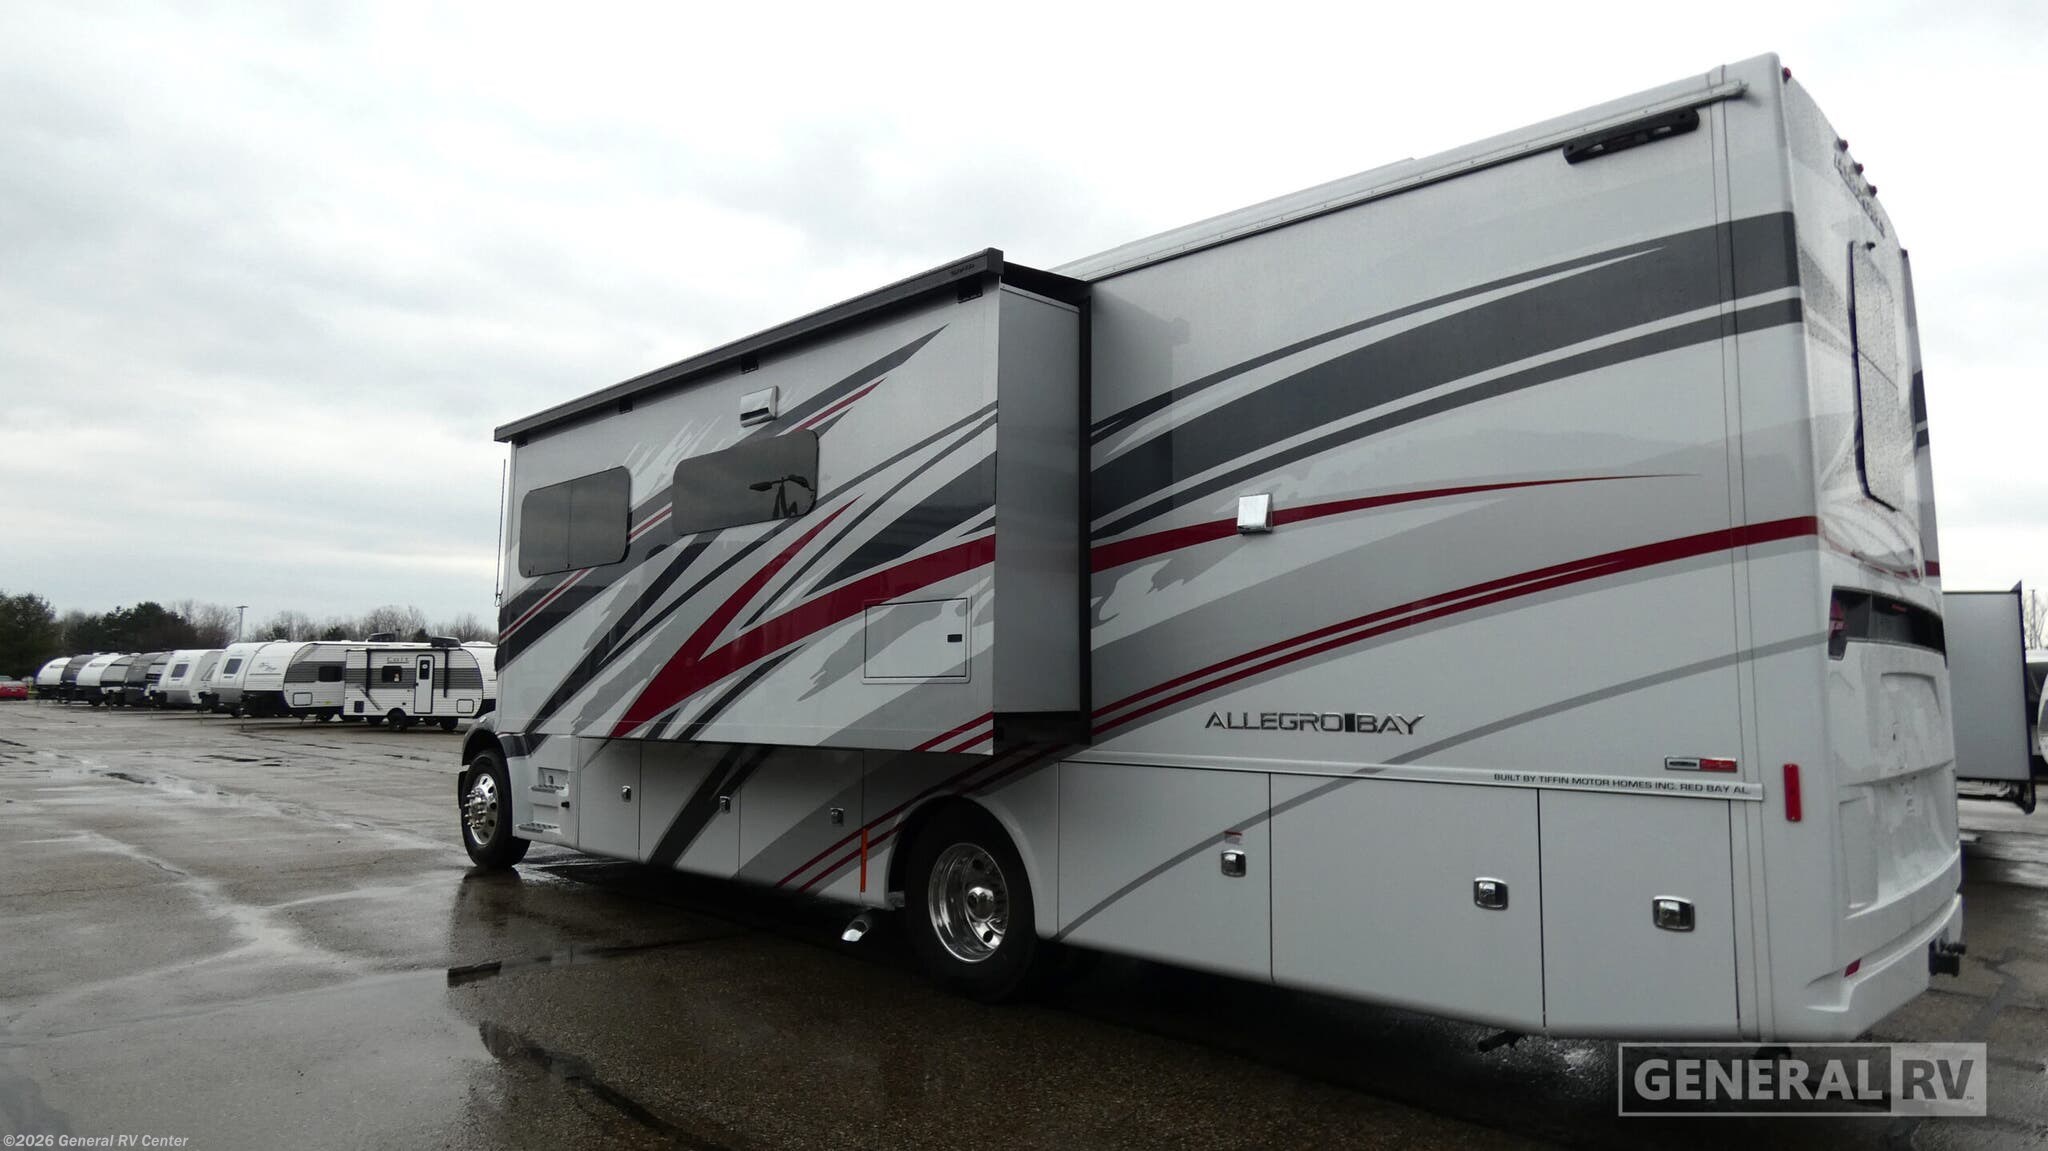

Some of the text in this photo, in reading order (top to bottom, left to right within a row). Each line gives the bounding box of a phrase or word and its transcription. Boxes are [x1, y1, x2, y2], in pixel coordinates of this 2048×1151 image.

[1204, 711, 1425, 734] ALLEGRO BAY
[1494, 773, 1520, 781] BUILT
[1523, 774, 1536, 782] BY
[1539, 775, 1569, 784] TIFFIN
[1572, 777, 1609, 786] MOTOR
[1612, 779, 1652, 789] HOMES
[1680, 783, 1703, 792] RED
[1706, 785, 1730, 793] BAY
